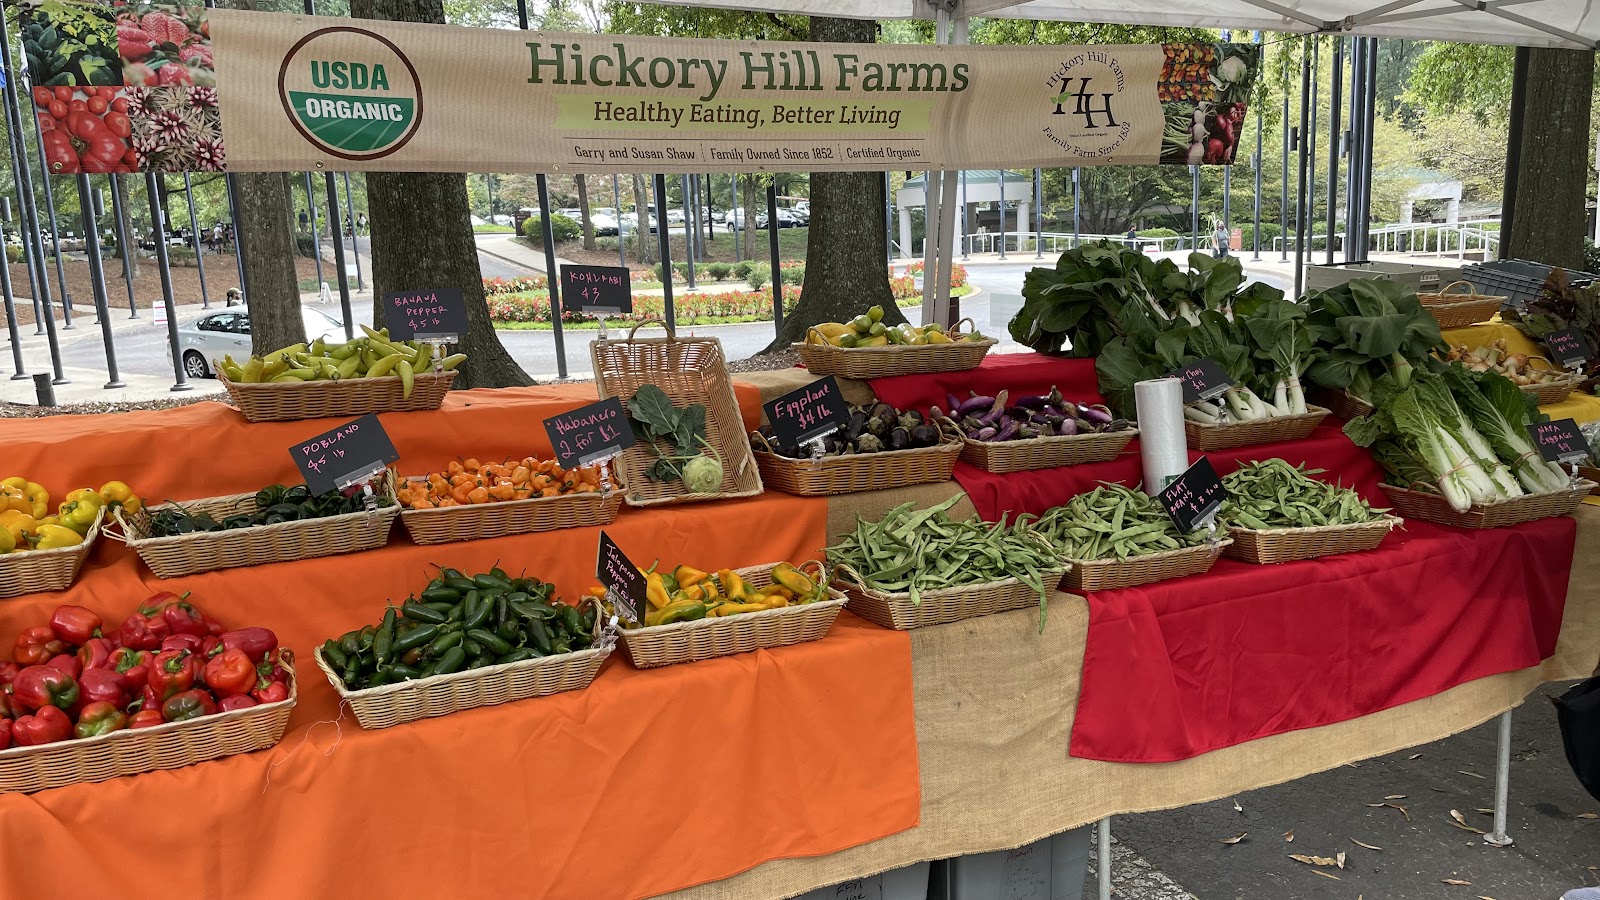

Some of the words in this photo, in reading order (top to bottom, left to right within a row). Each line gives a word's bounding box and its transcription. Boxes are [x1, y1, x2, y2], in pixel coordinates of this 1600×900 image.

[311, 60, 390, 91] USDA
[525, 42, 728, 102] Hickory
[739, 50, 823, 91] Hill
[833, 53, 969, 92] Farms
[1046, 54, 1084, 88] Hickory
[1087, 51, 1107, 64] Hill
[1109, 58, 1125, 92] Farms
[305, 98, 403, 122] ORGANIC
[594, 101, 684, 129] Healthy
[689, 103, 765, 129] Eating,
[771, 105, 835, 124] Better
[839, 105, 902, 129] Living
[1043, 126, 1072, 152] Family
[1073, 146, 1096, 158] Farm
[1098, 140, 1121, 157] Since
[1118, 121, 1131, 141] 1852
[574, 146, 604, 161] Garry
[609, 146, 628, 159] and
[631, 147, 664, 160] Susan
[666, 147, 695, 160] Shaw
[710, 148, 743, 162] Family
[746, 147, 780, 160] Owned
[783, 147, 809, 160] Since
[812, 147, 832, 160] 1852
[847, 147, 884, 159] Certified
[887, 147, 921, 160] Organic
[394, 293, 438, 307] BANANA
[406, 305, 448, 316] PEPPER
[774, 384, 830, 419] Eggplant
[555, 408, 616, 435] Habanero
[799, 409, 815, 429] $4
[1537, 425, 1560, 433] NAPA
[302, 423, 359, 456] POBLANO
[560, 440, 575, 459] 2
[1165, 477, 1187, 502] FLAT
[1170, 490, 1193, 515] BEANS
[606, 543, 635, 581] Jalapeno
[606, 560, 628, 588] Peppers
